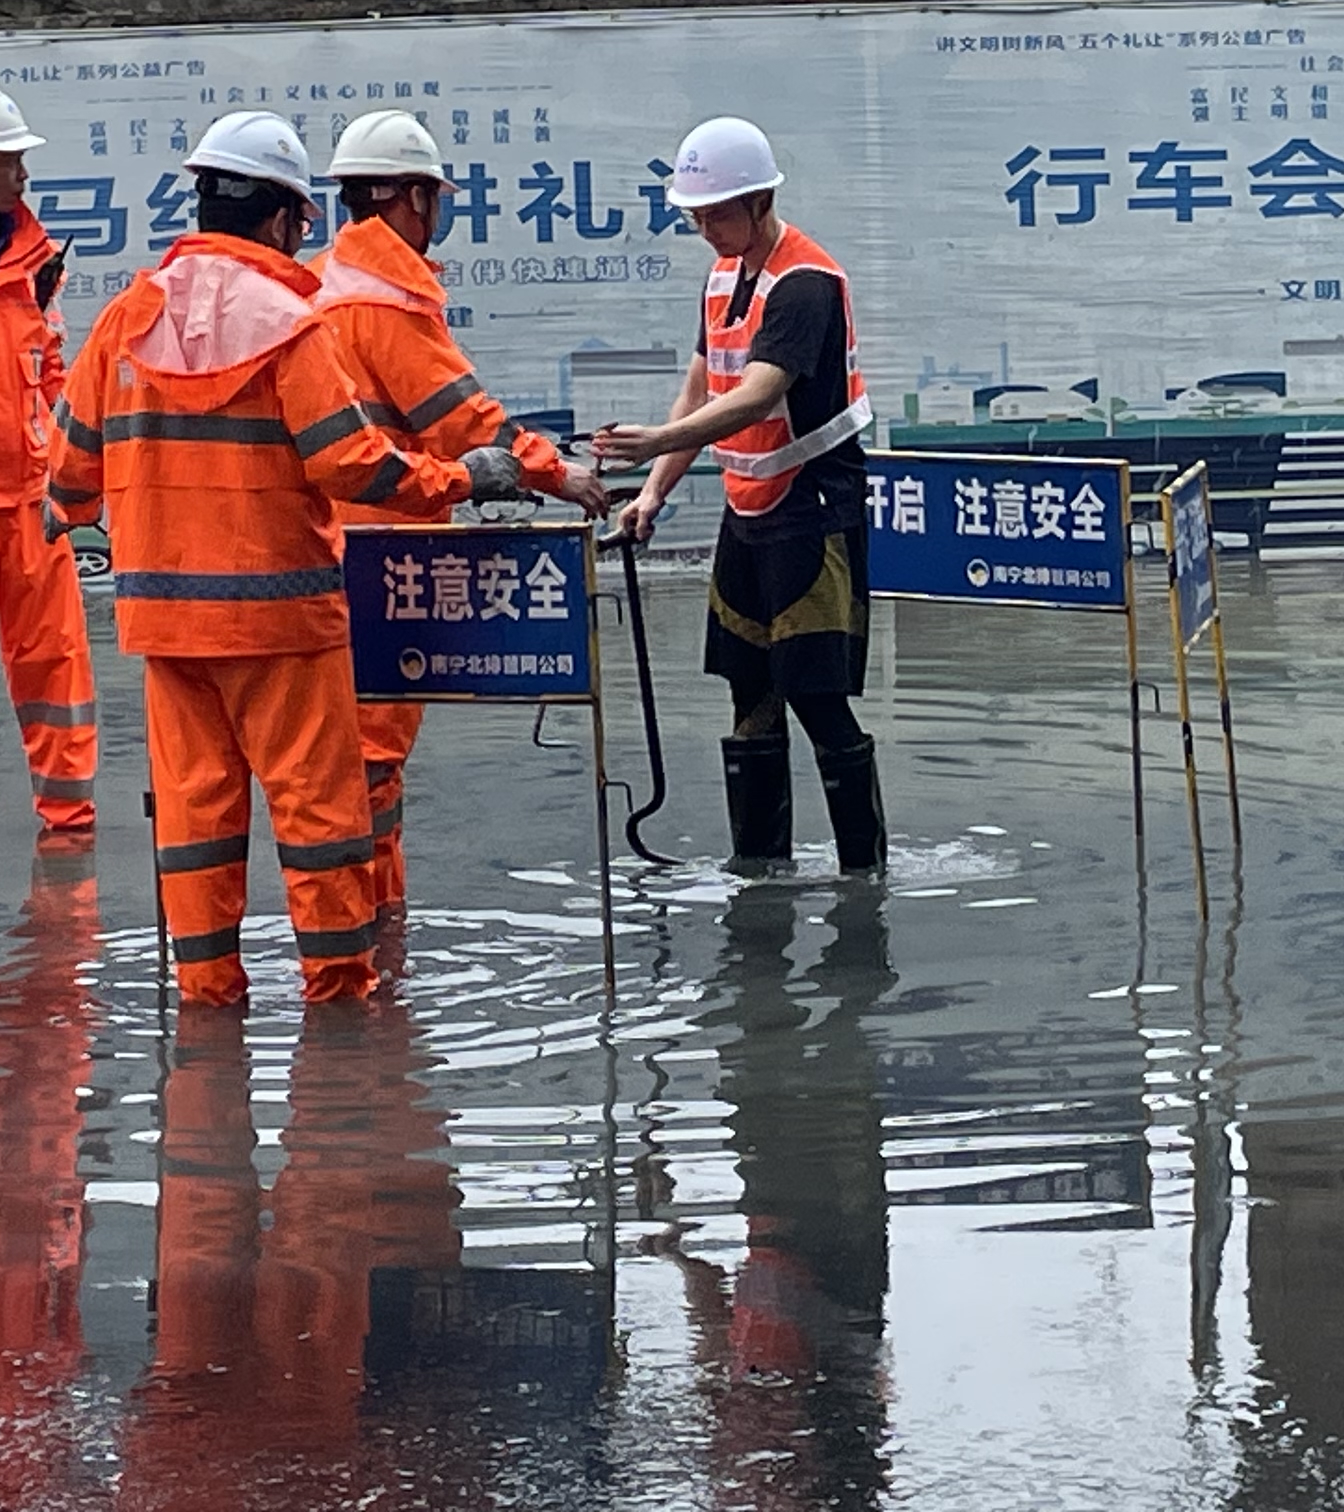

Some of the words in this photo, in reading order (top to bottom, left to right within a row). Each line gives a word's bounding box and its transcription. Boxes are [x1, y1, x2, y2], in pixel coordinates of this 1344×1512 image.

[200, 81, 440, 104] 社会主义核心价值观
[955, 477, 1106, 541] 注意安全
[383, 551, 569, 621] 注意安全
